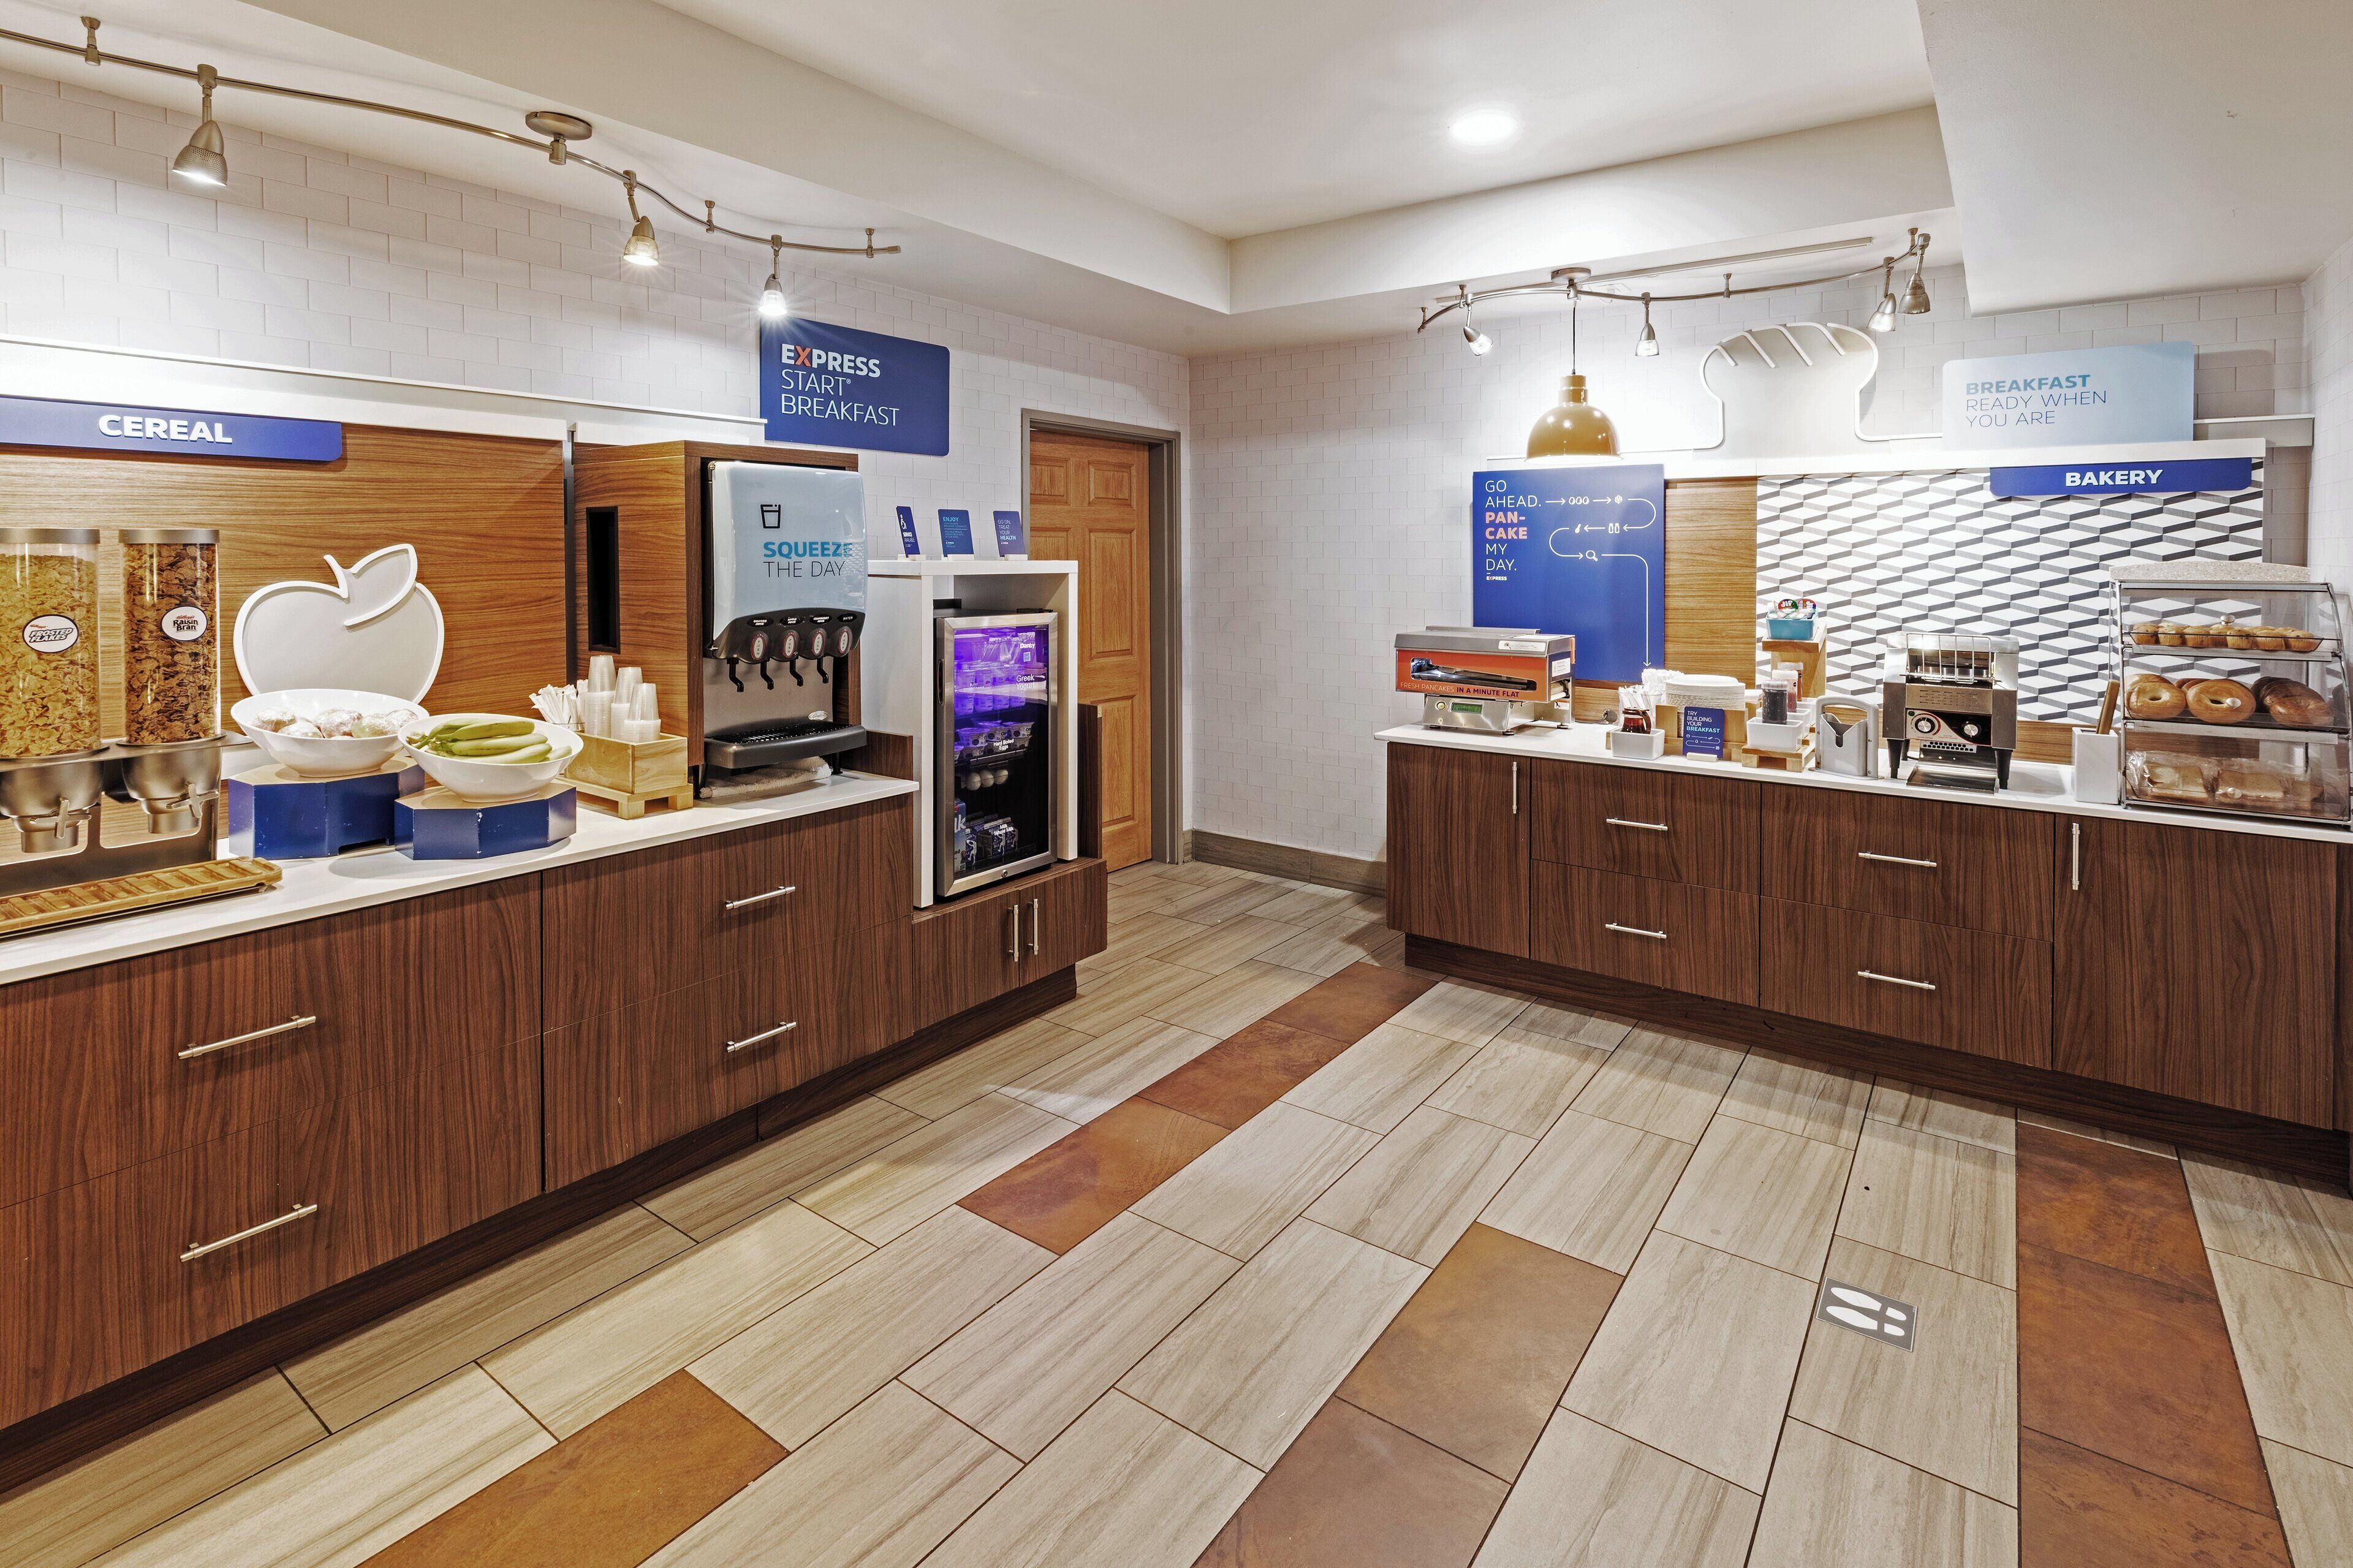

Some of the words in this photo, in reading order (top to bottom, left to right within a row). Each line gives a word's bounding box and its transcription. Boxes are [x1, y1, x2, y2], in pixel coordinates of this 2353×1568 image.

[781, 343, 881, 377] EXPRESS
[1966, 374, 2091, 395] BREAKFAST
[1966, 395, 2032, 411] READY
[2041, 390, 2106, 407] WHEN
[781, 393, 900, 426] BREAKFAST
[1966, 414, 2007, 428] YOU
[2016, 411, 2055, 425] ARE
[99, 415, 233, 444] CEREAL
[2066, 469, 2163, 487] BAKERY
[1485, 480, 1507, 492] GO
[1485, 495, 1542, 507] AHEAD.
[1485, 512, 1525, 523] PAN-
[1485, 527, 1528, 539] CAKE
[763, 542, 853, 559] SQUEEZE
[1486, 543, 1507, 555] MY
[763, 561, 802, 577] THE
[811, 561, 845, 577] DAY
[1486, 559, 1517, 571] DAY.
[29, 628, 73, 637] FROSTED
[29, 634, 67, 643] FLAKES
[1016, 681, 1035, 691] Yogurt
